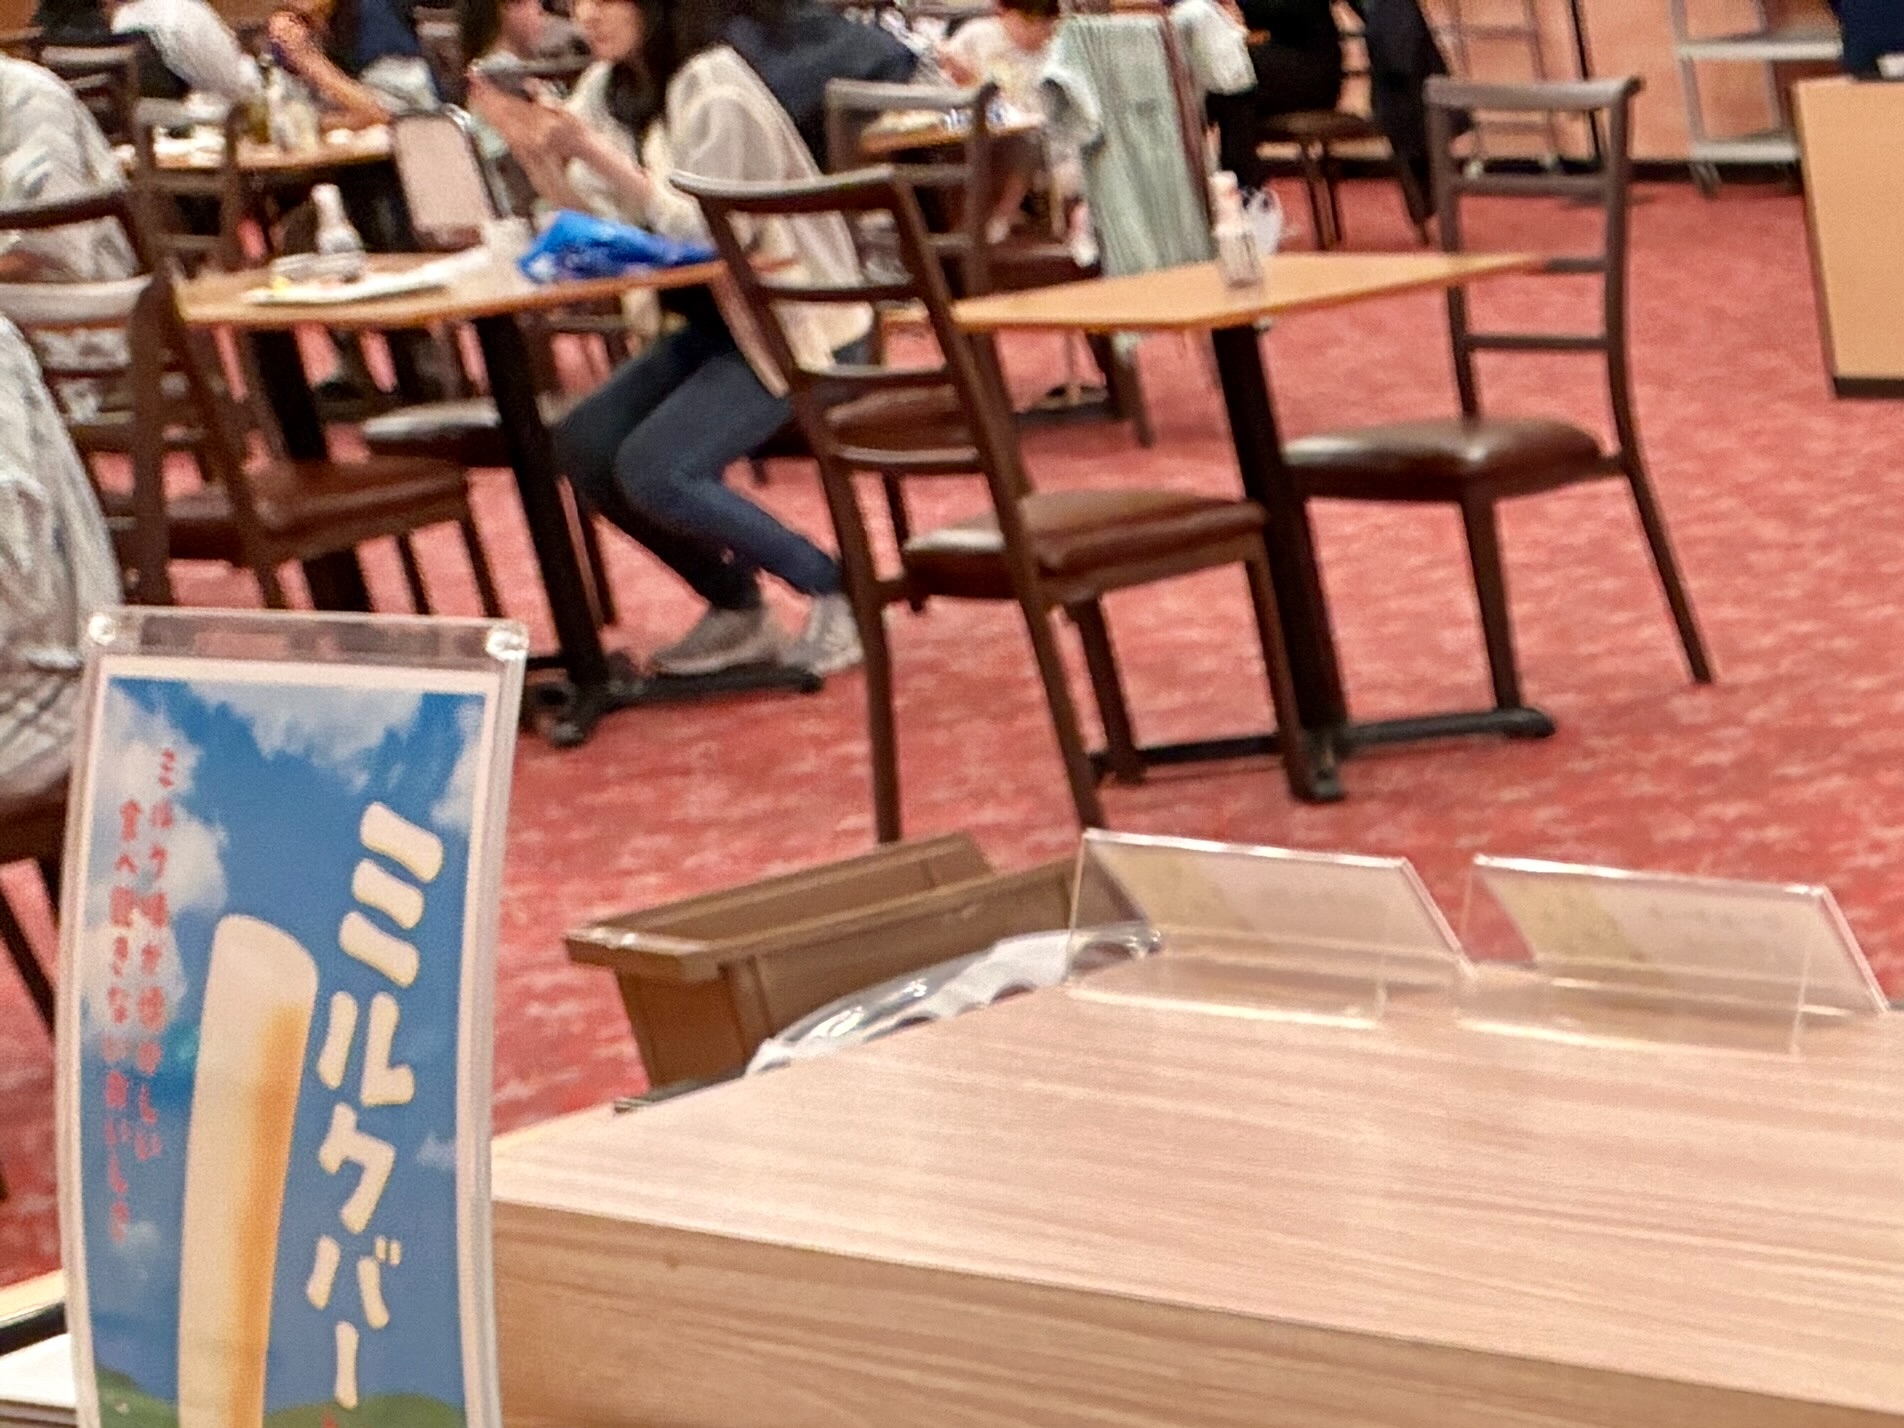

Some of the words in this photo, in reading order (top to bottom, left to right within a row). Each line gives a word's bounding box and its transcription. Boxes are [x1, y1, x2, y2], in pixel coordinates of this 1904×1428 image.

[305, 800, 445, 1410] ミルクバー
